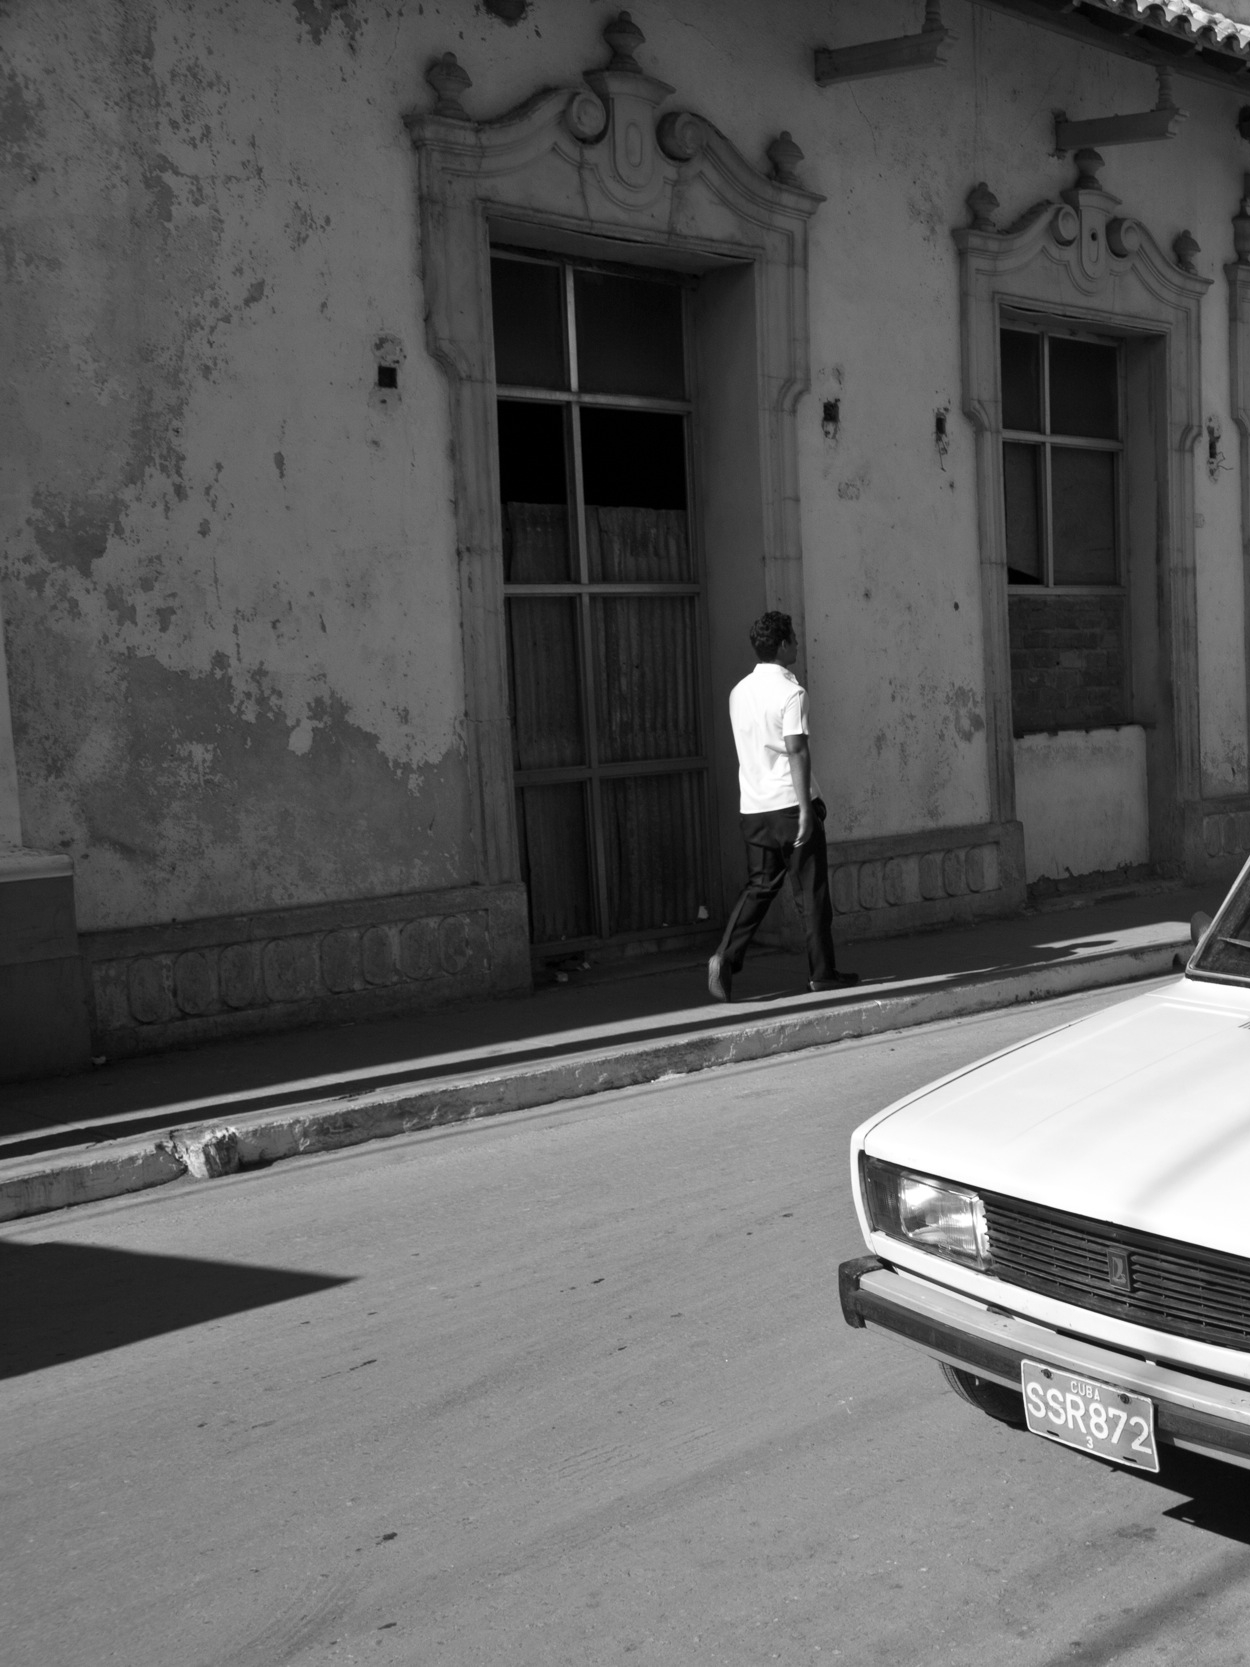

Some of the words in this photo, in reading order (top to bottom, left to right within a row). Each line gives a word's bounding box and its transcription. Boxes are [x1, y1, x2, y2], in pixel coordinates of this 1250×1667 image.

[1070, 1380, 1101, 1401] CUBA
[1026, 1381, 1153, 1455] SSR872
[1085, 1435, 1095, 1449] 3
